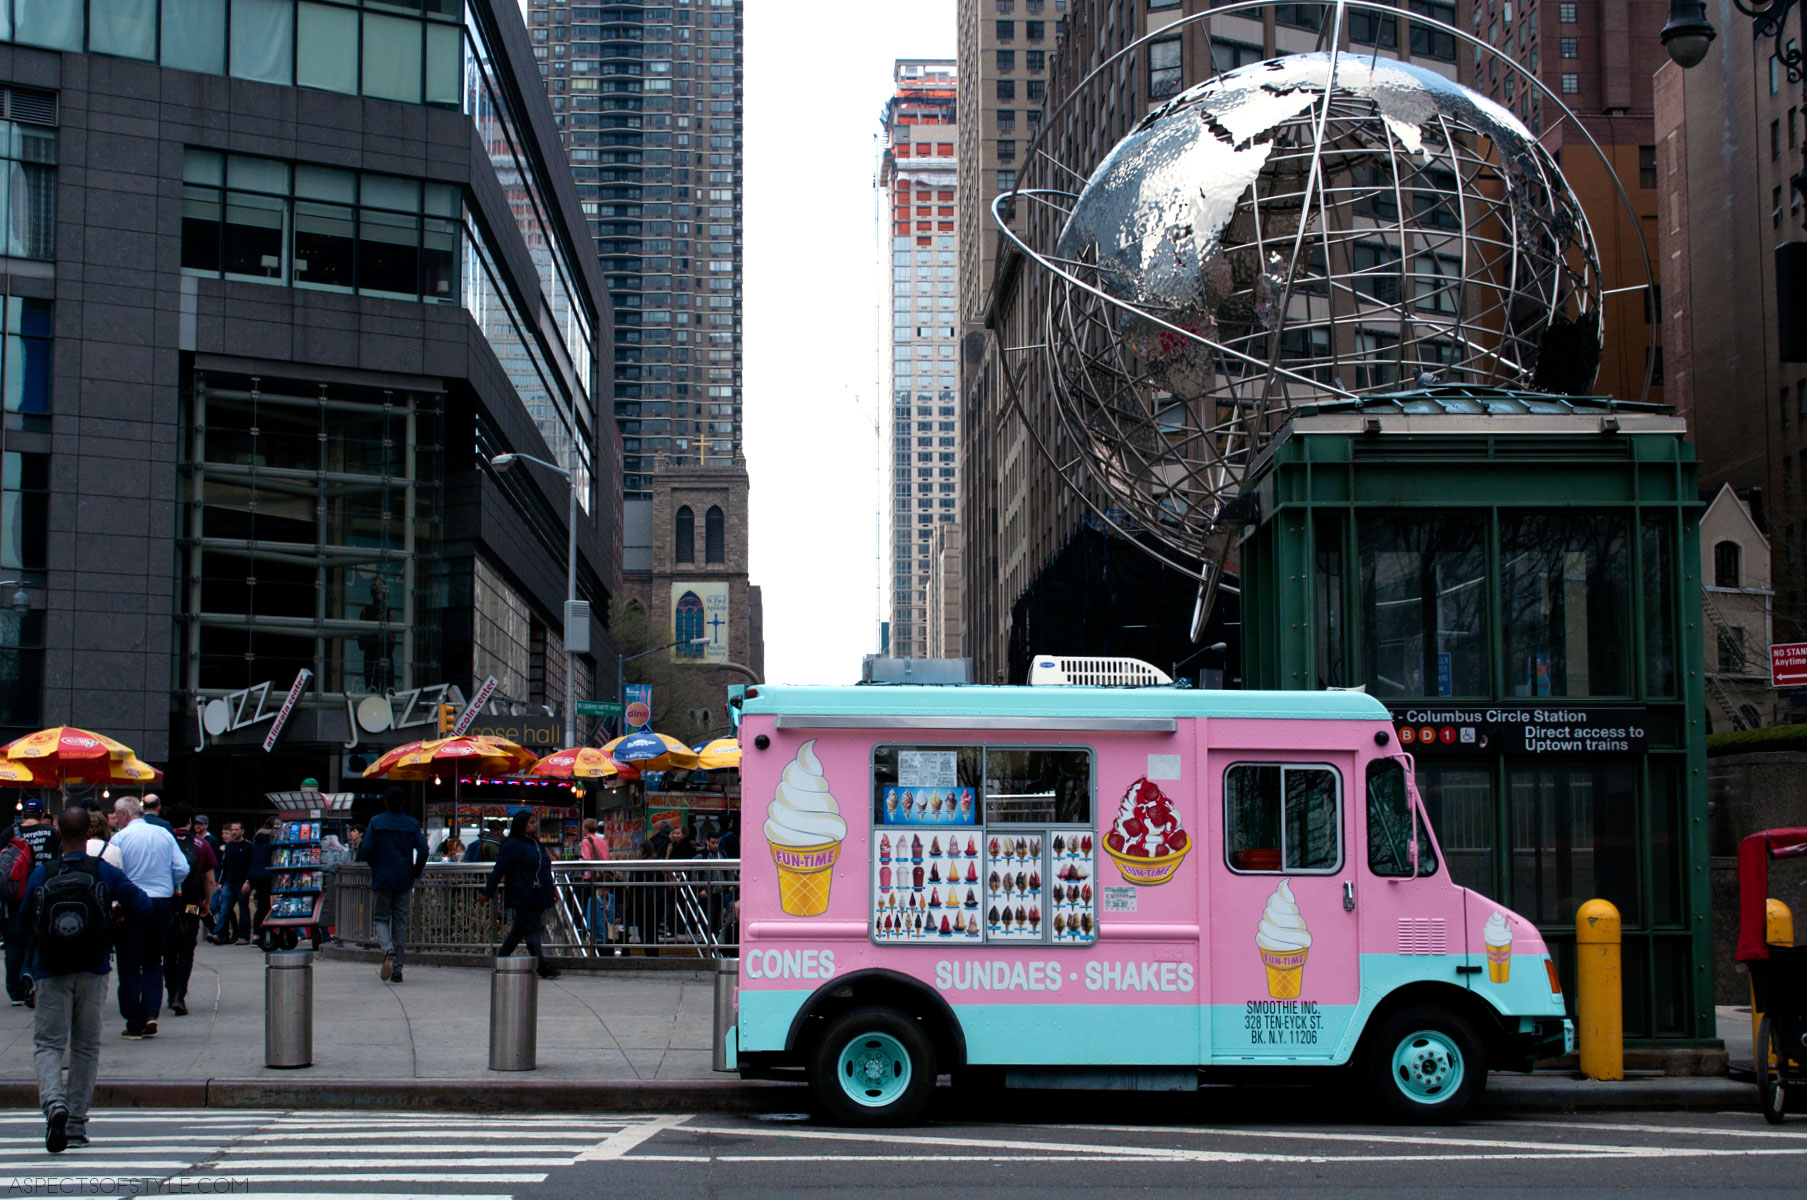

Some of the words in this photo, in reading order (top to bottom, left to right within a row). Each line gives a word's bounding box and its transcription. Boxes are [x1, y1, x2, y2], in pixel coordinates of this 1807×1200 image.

[1773, 649, 1785, 657] NO
[1787, 647, 1807, 656] STAN
[1775, 658, 1807, 667] Anytime
[473, 679, 496, 709] center
[194, 680, 279, 752] jazz
[266, 736, 275, 747] at
[271, 705, 290, 736] lincoln
[288, 675, 304, 705] center
[627, 710, 649, 718] dine
[1406, 710, 1482, 722] Columbus
[1486, 710, 1530, 722] Circle
[1534, 710, 1587, 722] Station
[523, 723, 560, 743] hall
[1402, 730, 1412, 740] B
[1423, 730, 1433, 740] D
[1525, 726, 1570, 738] Direct
[1574, 728, 1626, 738] access
[1629, 726, 1644, 738] to
[1525, 739, 1582, 753] Uptown
[1585, 739, 1629, 751] trains
[775, 849, 835, 868] FUN-TIME
[1121, 863, 1174, 878] FUN-TIME
[745, 948, 836, 981] CONES
[1264, 953, 1305, 966] FUN-TIME
[934, 961, 1063, 992] SUNDAES
[1084, 961, 1195, 993] SHAKES
[1246, 1000, 1298, 1014] SMOOTHIE
[1300, 1000, 1321, 1014] INC.
[1244, 1015, 1261, 1029] 328
[1264, 1015, 1307, 1029] TEN-EYCK
[1309, 1015, 1324, 1029] ST.
[1251, 1030, 1266, 1044] BK.
[1269, 1030, 1286, 1044] N.Y.
[1290, 1030, 1317, 1044] 11206
